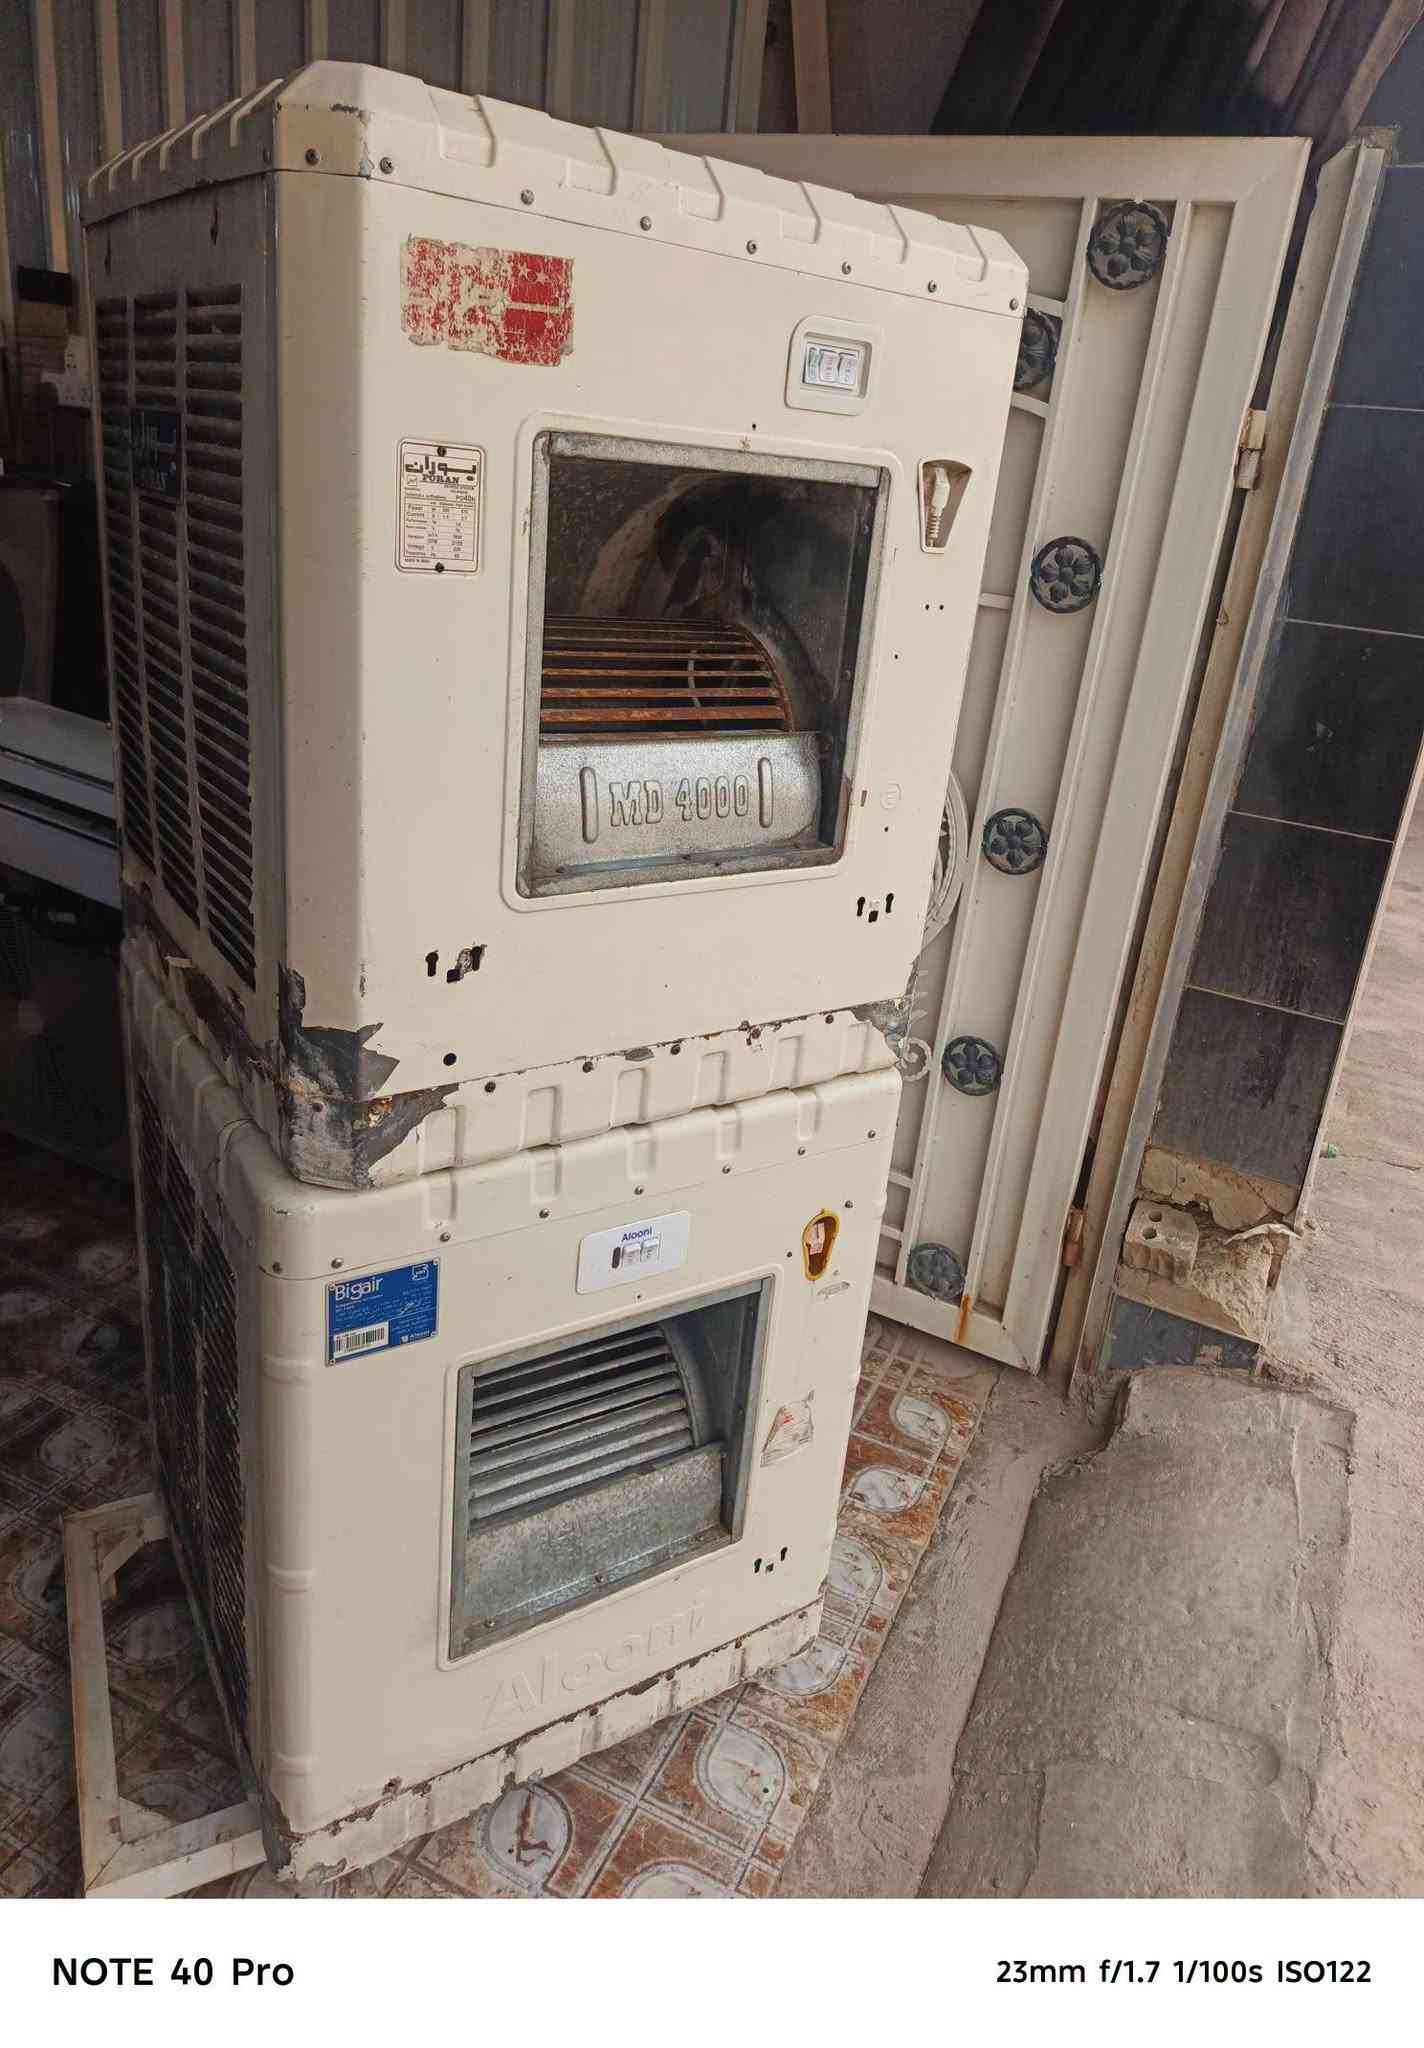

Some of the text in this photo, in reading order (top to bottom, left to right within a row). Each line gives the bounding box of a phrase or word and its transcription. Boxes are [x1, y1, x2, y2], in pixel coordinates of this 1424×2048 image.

[609, 775, 749, 827] MD 4000
[335, 1277, 384, 1301] Bigair
